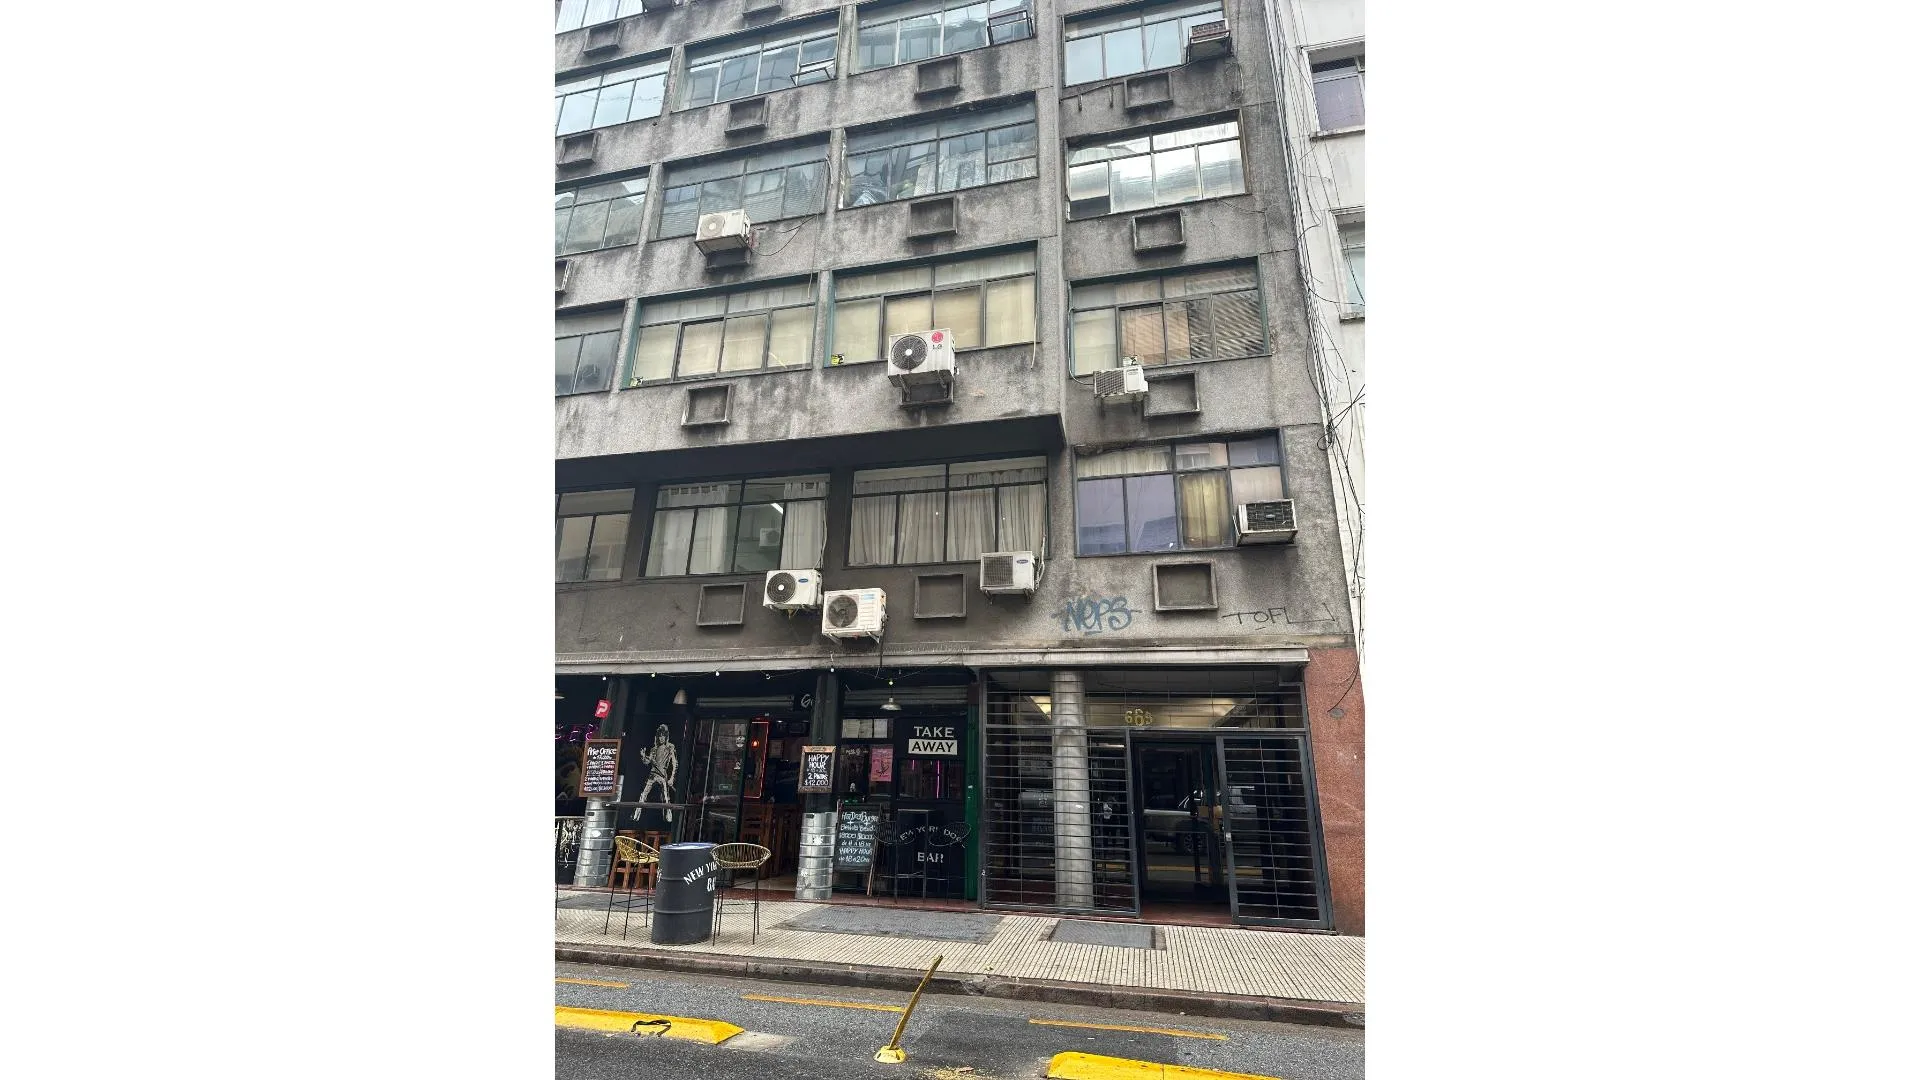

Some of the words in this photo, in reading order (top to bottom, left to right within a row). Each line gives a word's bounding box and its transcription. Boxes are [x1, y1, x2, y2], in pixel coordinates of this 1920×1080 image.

[913, 725, 955, 738] TAKE
[911, 740, 954, 753] AWAY
[808, 753, 829, 761] HAPPY
[808, 761, 826, 770] HOUR
[808, 772, 813, 780] 2
[917, 851, 944, 863] BAR
[683, 865, 704, 886] NEW
